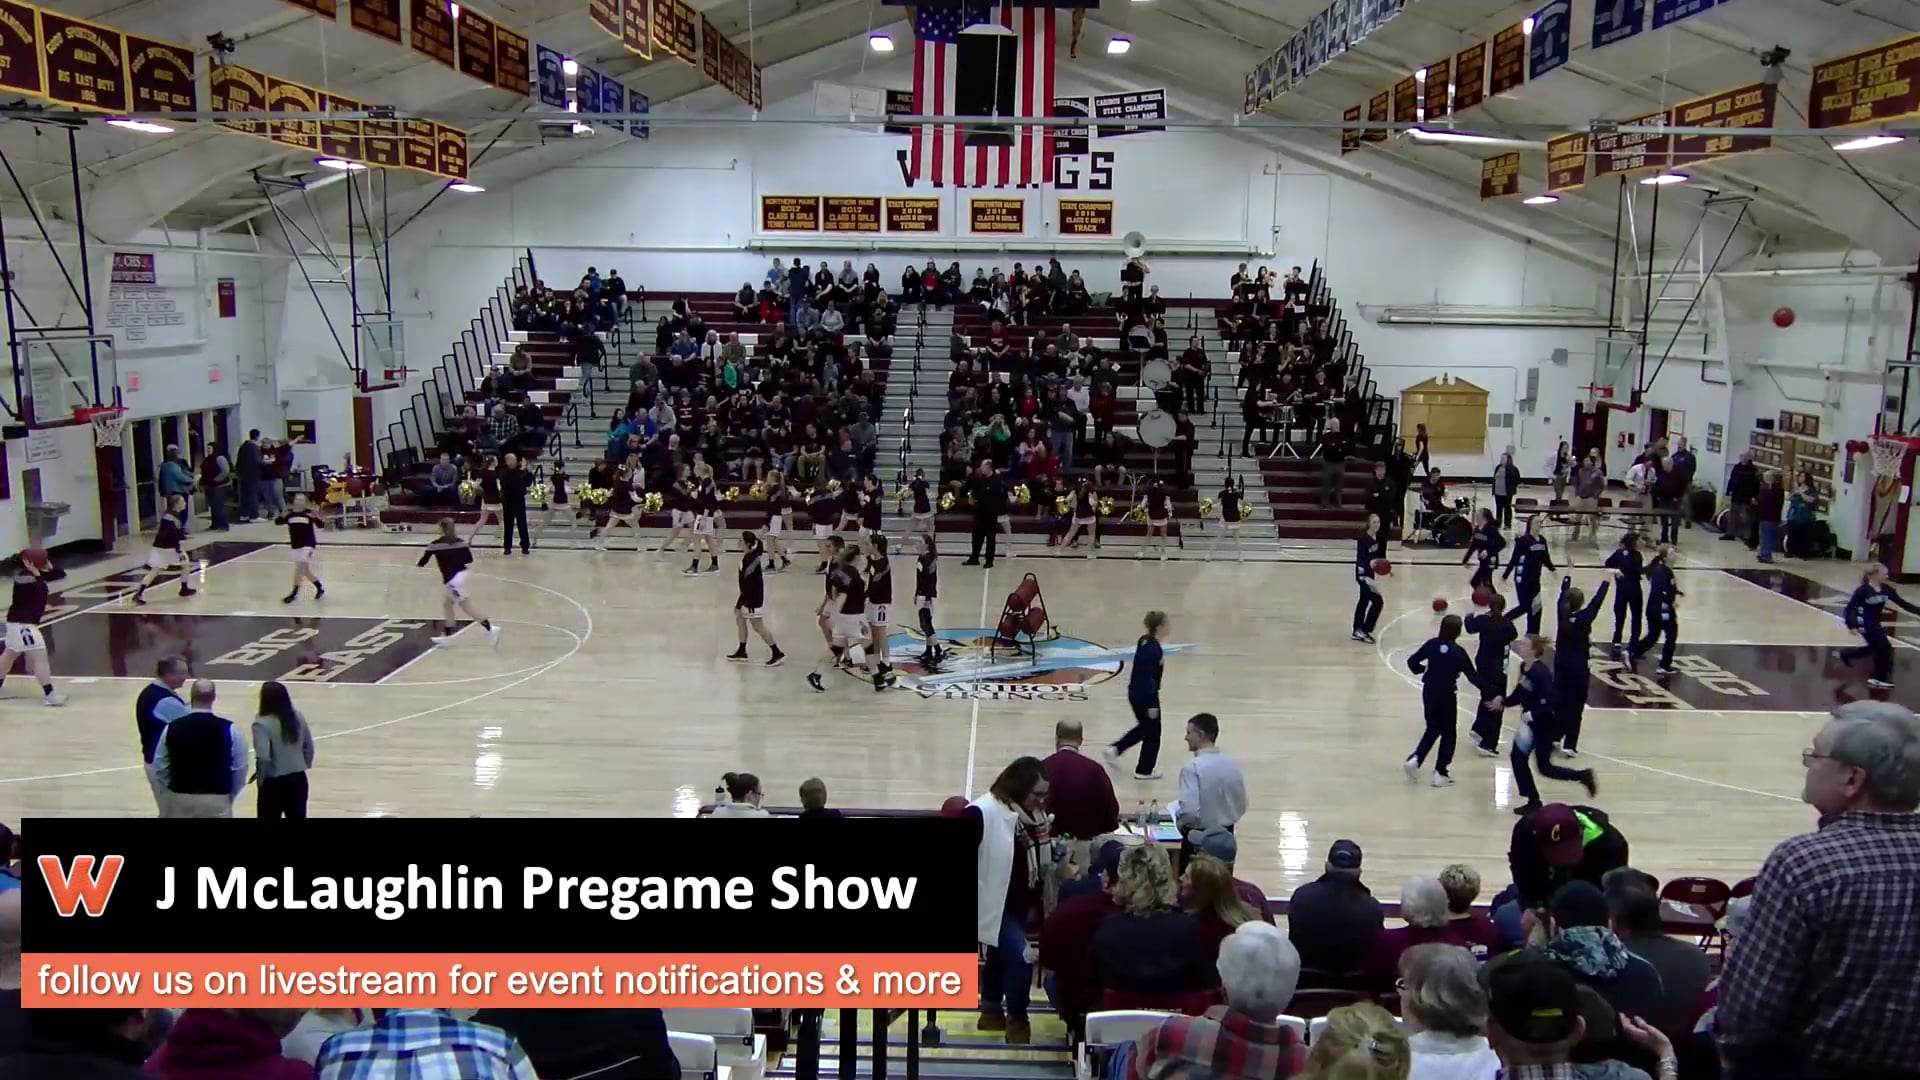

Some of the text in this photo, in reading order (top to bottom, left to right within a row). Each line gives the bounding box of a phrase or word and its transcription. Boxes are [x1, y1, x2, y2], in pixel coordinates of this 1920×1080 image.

[204, 628, 319, 666] BIG
[276, 619, 427, 682] EAST
[916, 683, 1087, 693] CARIBOU
[1588, 647, 1697, 710] AST
